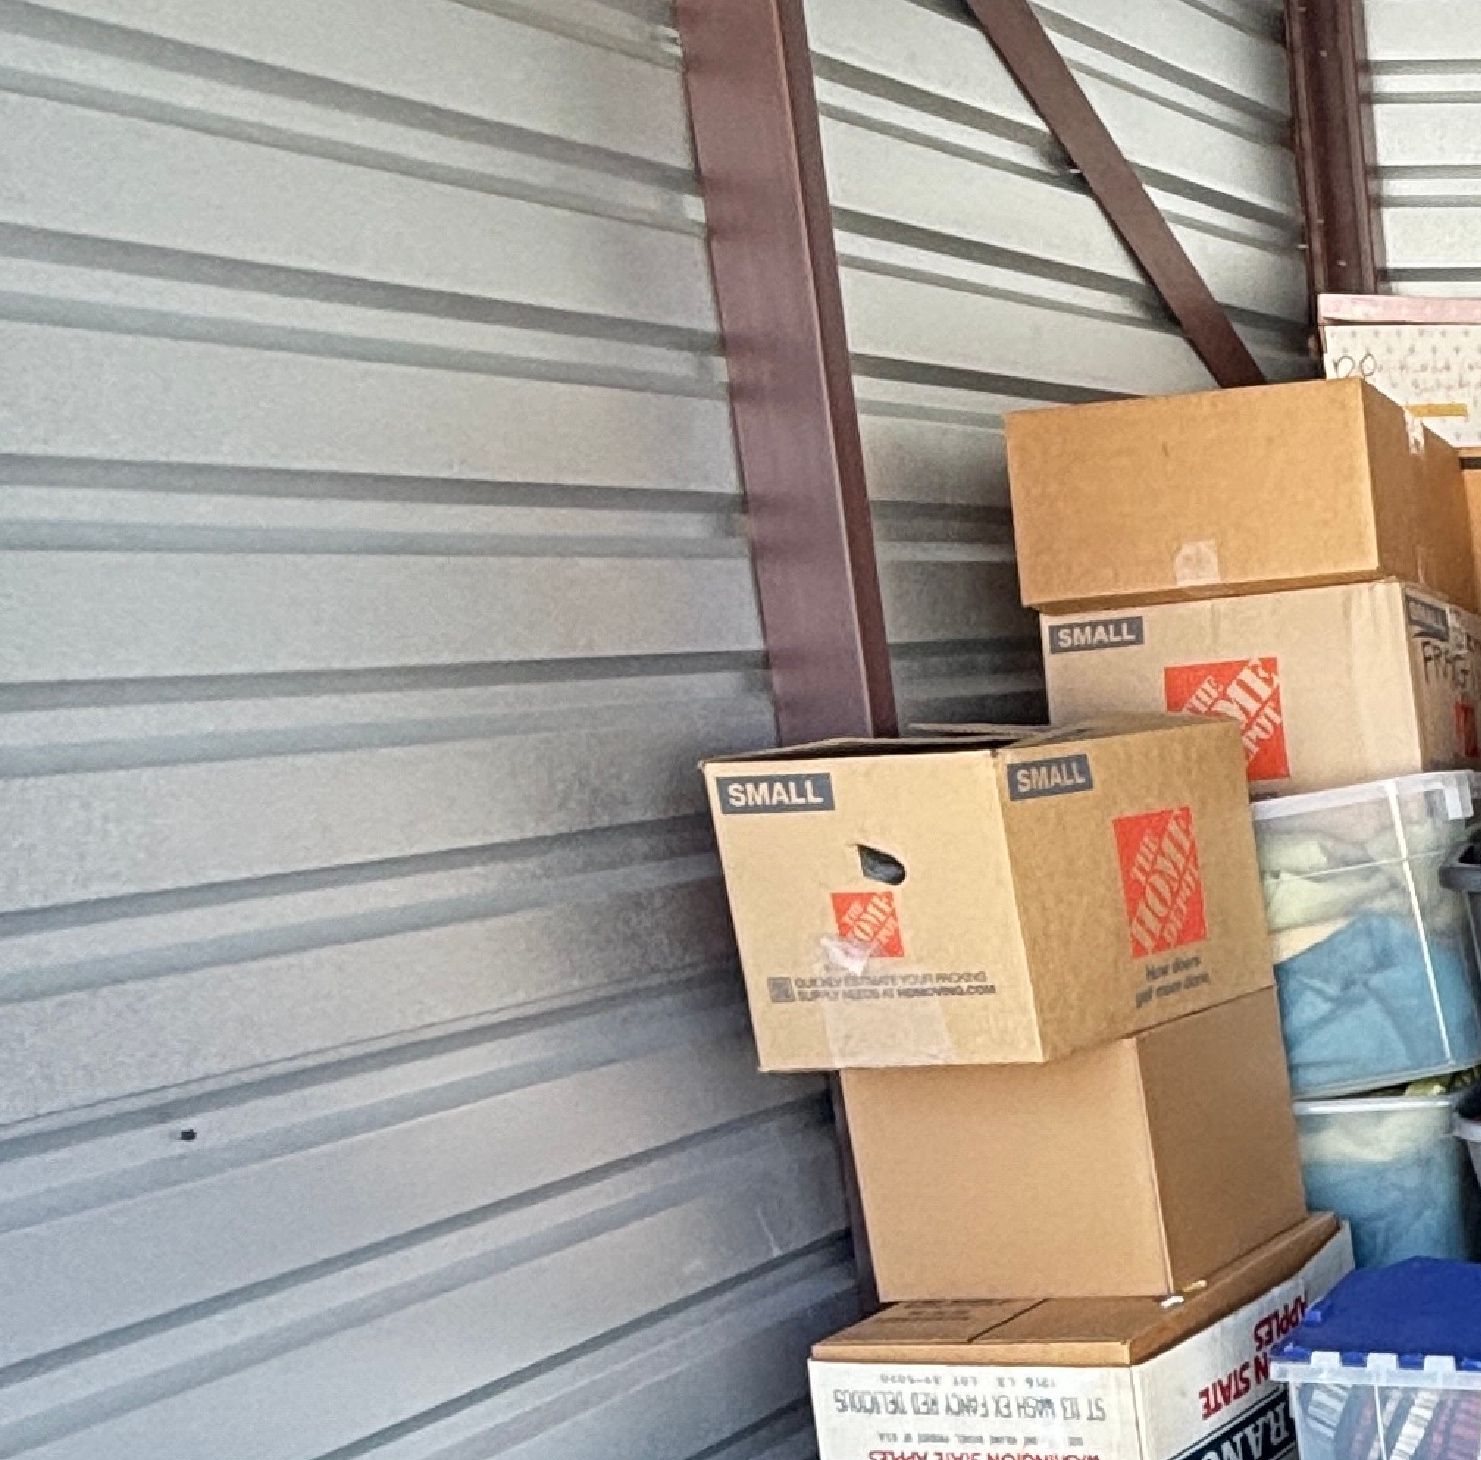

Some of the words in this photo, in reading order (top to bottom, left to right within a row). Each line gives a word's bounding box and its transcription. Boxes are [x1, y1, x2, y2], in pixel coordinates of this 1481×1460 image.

[1057, 621, 1136, 648] SMALL
[1017, 757, 1087, 794] SMALL
[727, 780, 824, 808] SMALL
[1131, 806, 1193, 952] HOME
[910, 1390, 940, 1416] RED
[1199, 1361, 1251, 1420] STATE
[945, 1392, 990, 1418] FANCY
[1016, 1395, 1056, 1419] WASH
